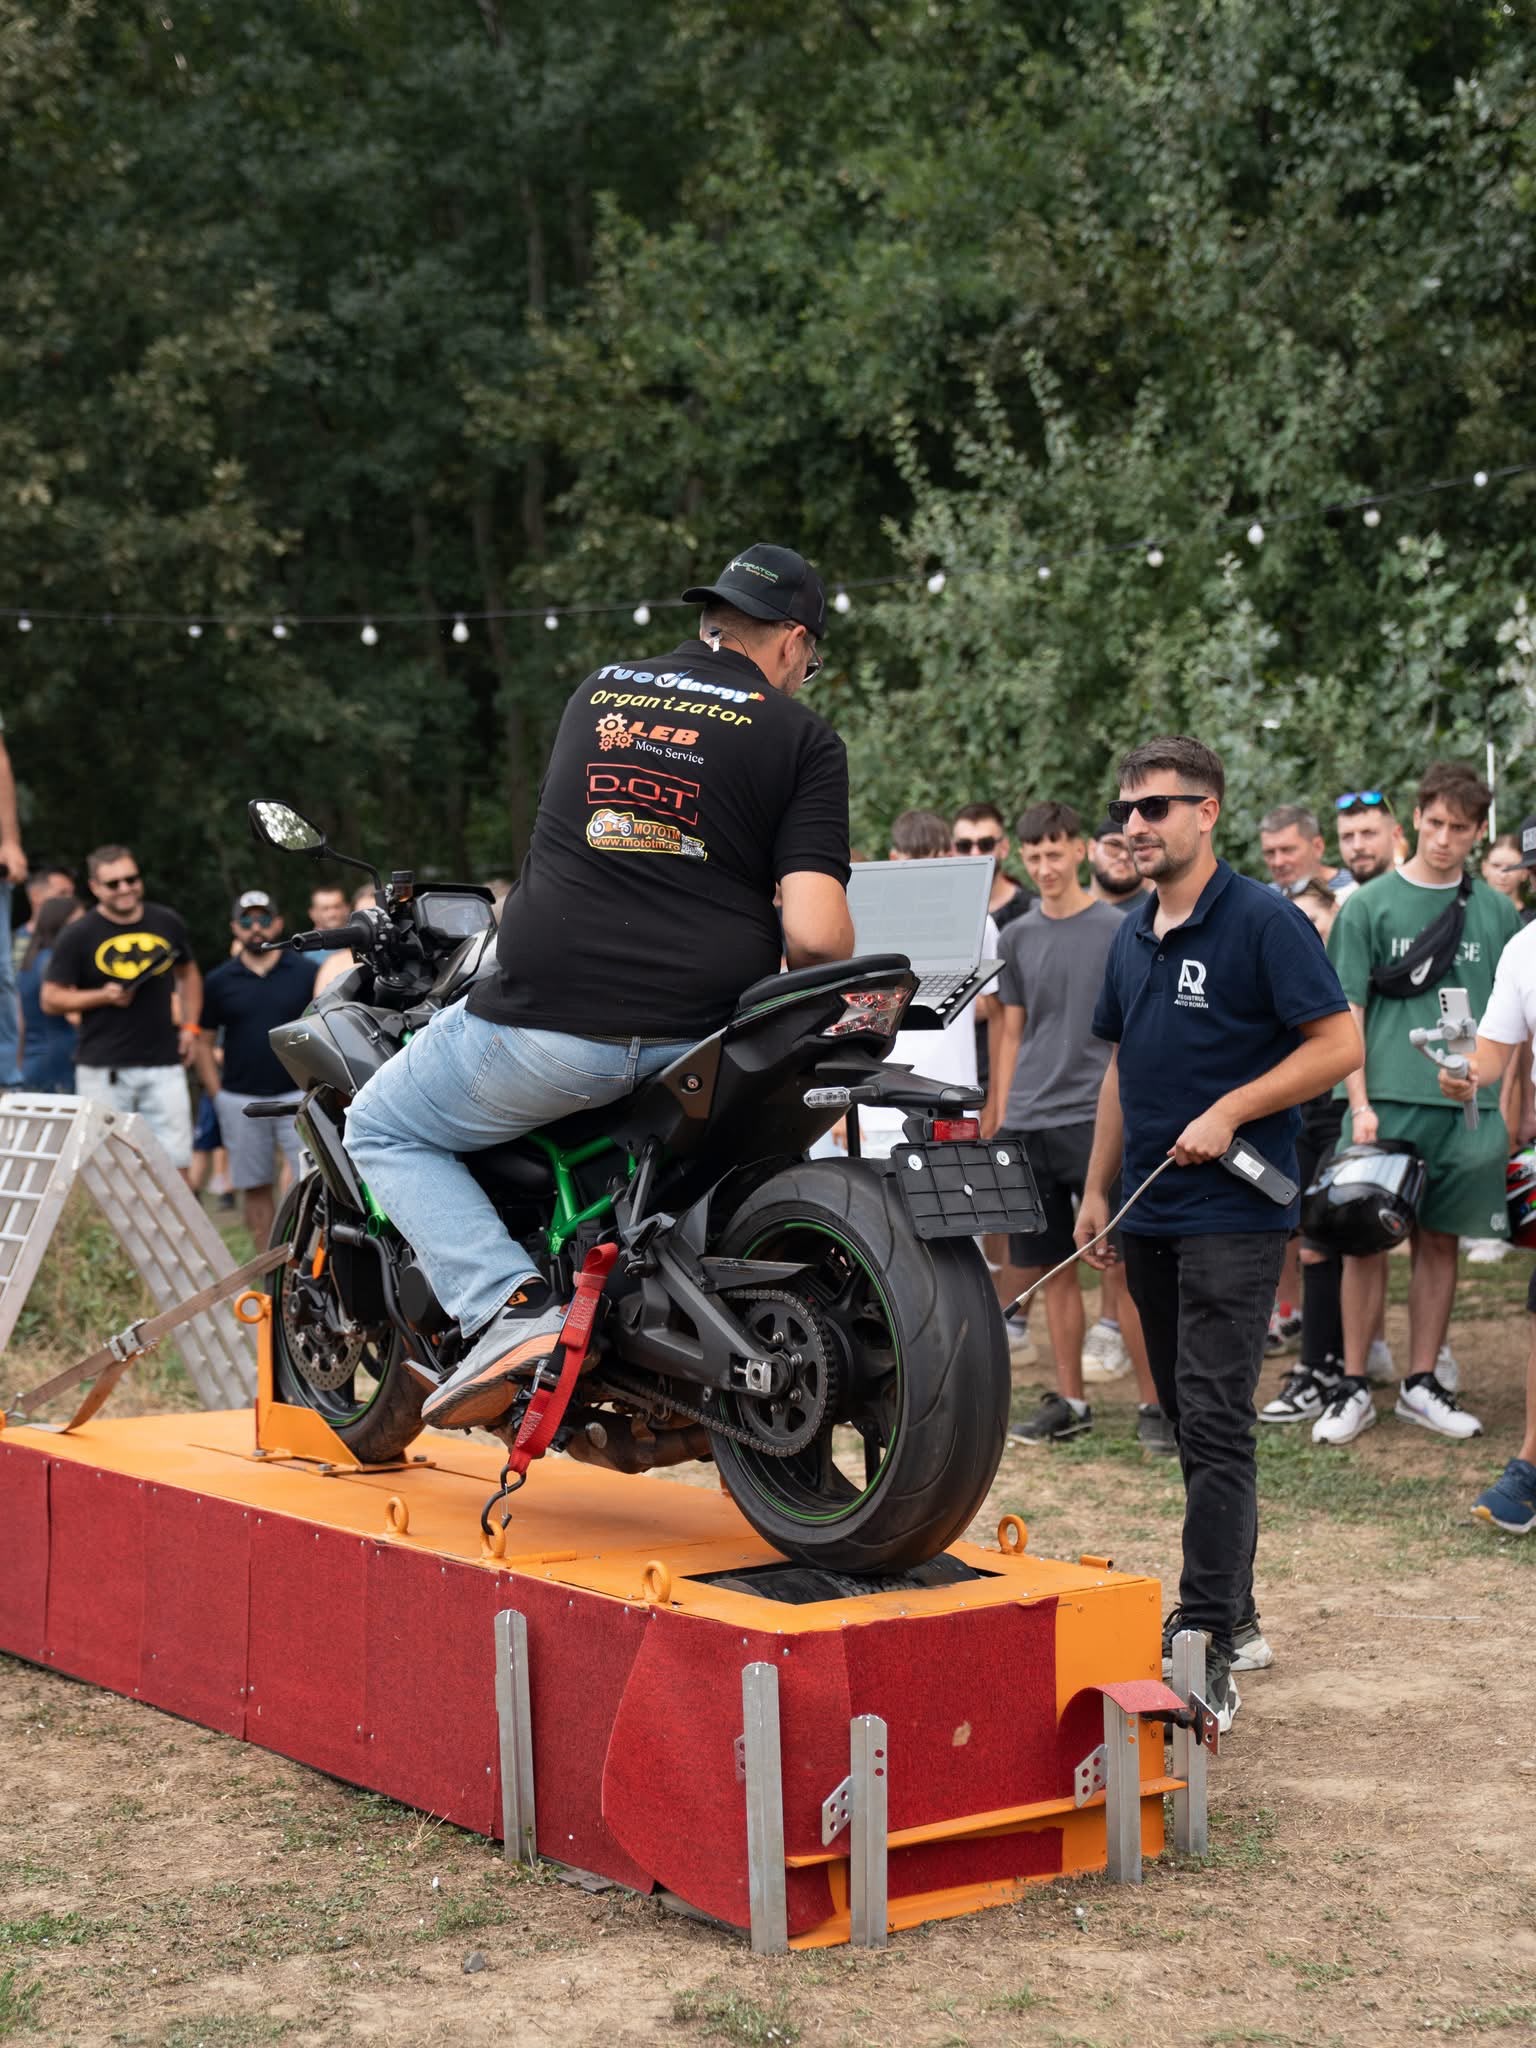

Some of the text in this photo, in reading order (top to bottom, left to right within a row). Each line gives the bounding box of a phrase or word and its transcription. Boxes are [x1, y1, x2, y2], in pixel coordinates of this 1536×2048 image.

[590, 690, 753, 726] Organizator
[628, 721, 701, 746] LEB
[635, 740, 705, 765] Moto Service
[633, 822, 681, 840] MOTOTM
[591, 836, 681, 852] www.mototm.ro
